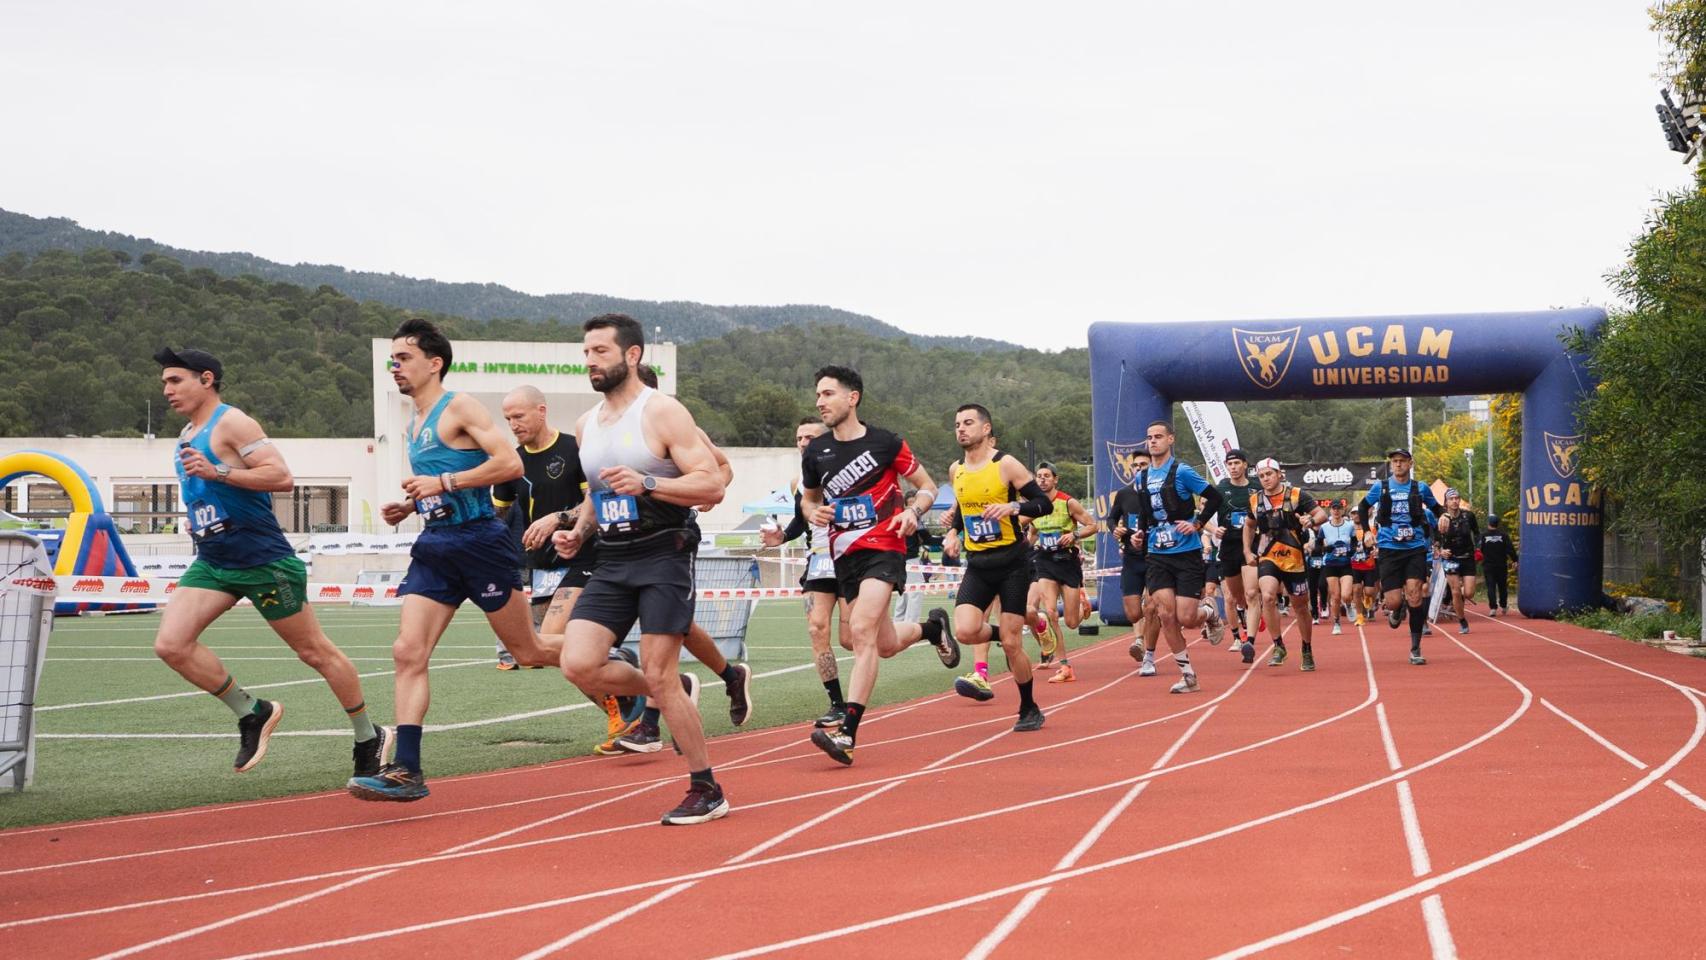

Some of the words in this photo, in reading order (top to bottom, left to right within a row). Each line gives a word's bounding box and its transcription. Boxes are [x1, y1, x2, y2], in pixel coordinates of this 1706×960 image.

[1249, 335, 1281, 343] UCAM
[1308, 324, 1454, 366] UCAM
[484, 362, 589, 375] INTERNATIONA
[1312, 364, 1449, 386] UNIVERSIDAD
[827, 450, 879, 495] PROJECT
[195, 504, 221, 528] 422
[601, 499, 630, 522] 484
[842, 503, 868, 521] 413
[972, 520, 994, 535] 511
